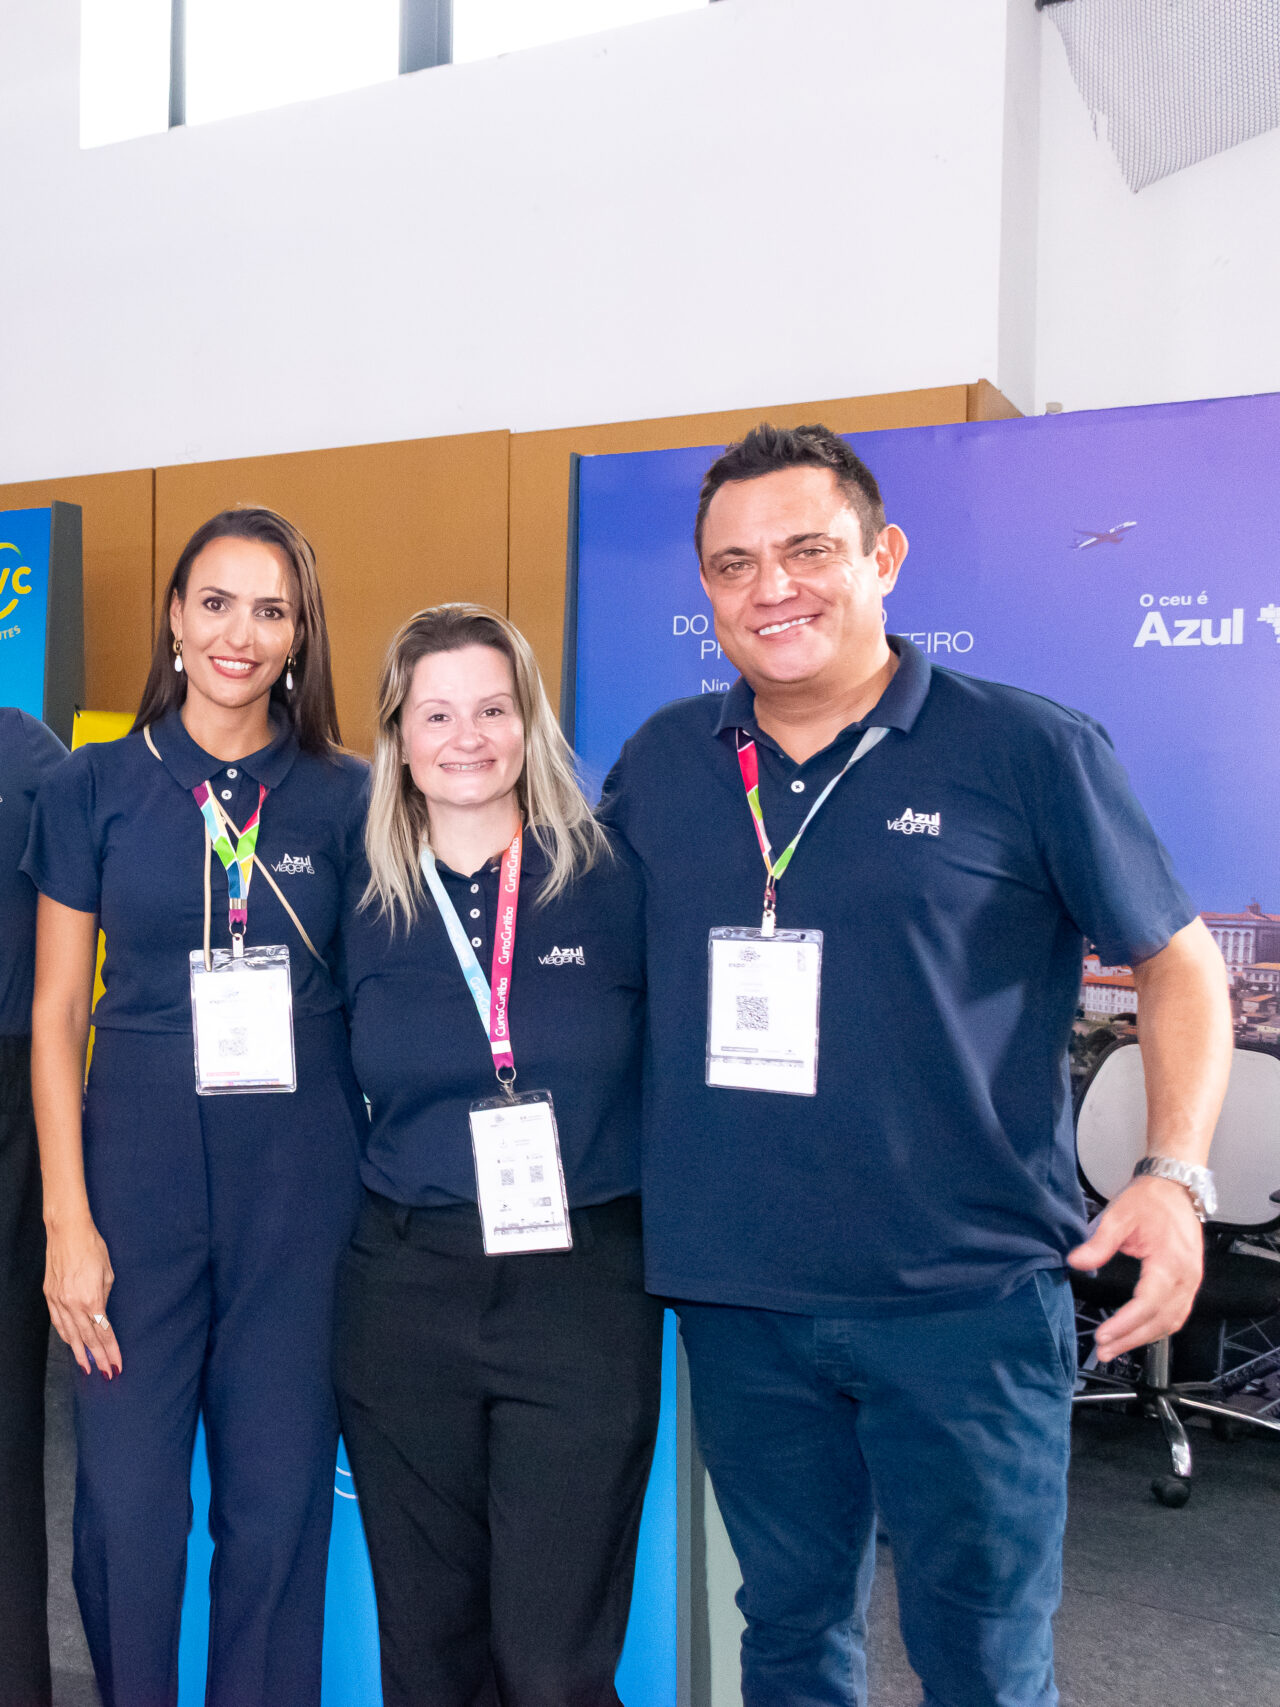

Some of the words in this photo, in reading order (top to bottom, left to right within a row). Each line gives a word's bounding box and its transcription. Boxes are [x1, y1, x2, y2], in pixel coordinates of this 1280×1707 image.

[1140, 593, 1154, 607] O
[1159, 595, 1192, 606] ceu
[1197, 590, 1208, 604] é
[673, 614, 708, 635] DO
[1133, 608, 1244, 647] Azul
[901, 808, 940, 825] Azul
[887, 818, 939, 835] viagens
[270, 861, 315, 875] viagens
[283, 853, 311, 866] Azul
[498, 906, 513, 964] CurtaCuritiba
[538, 954, 585, 965] viagens
[550, 946, 583, 957] Azul
[495, 977, 507, 1036] CurtaCuritiba
